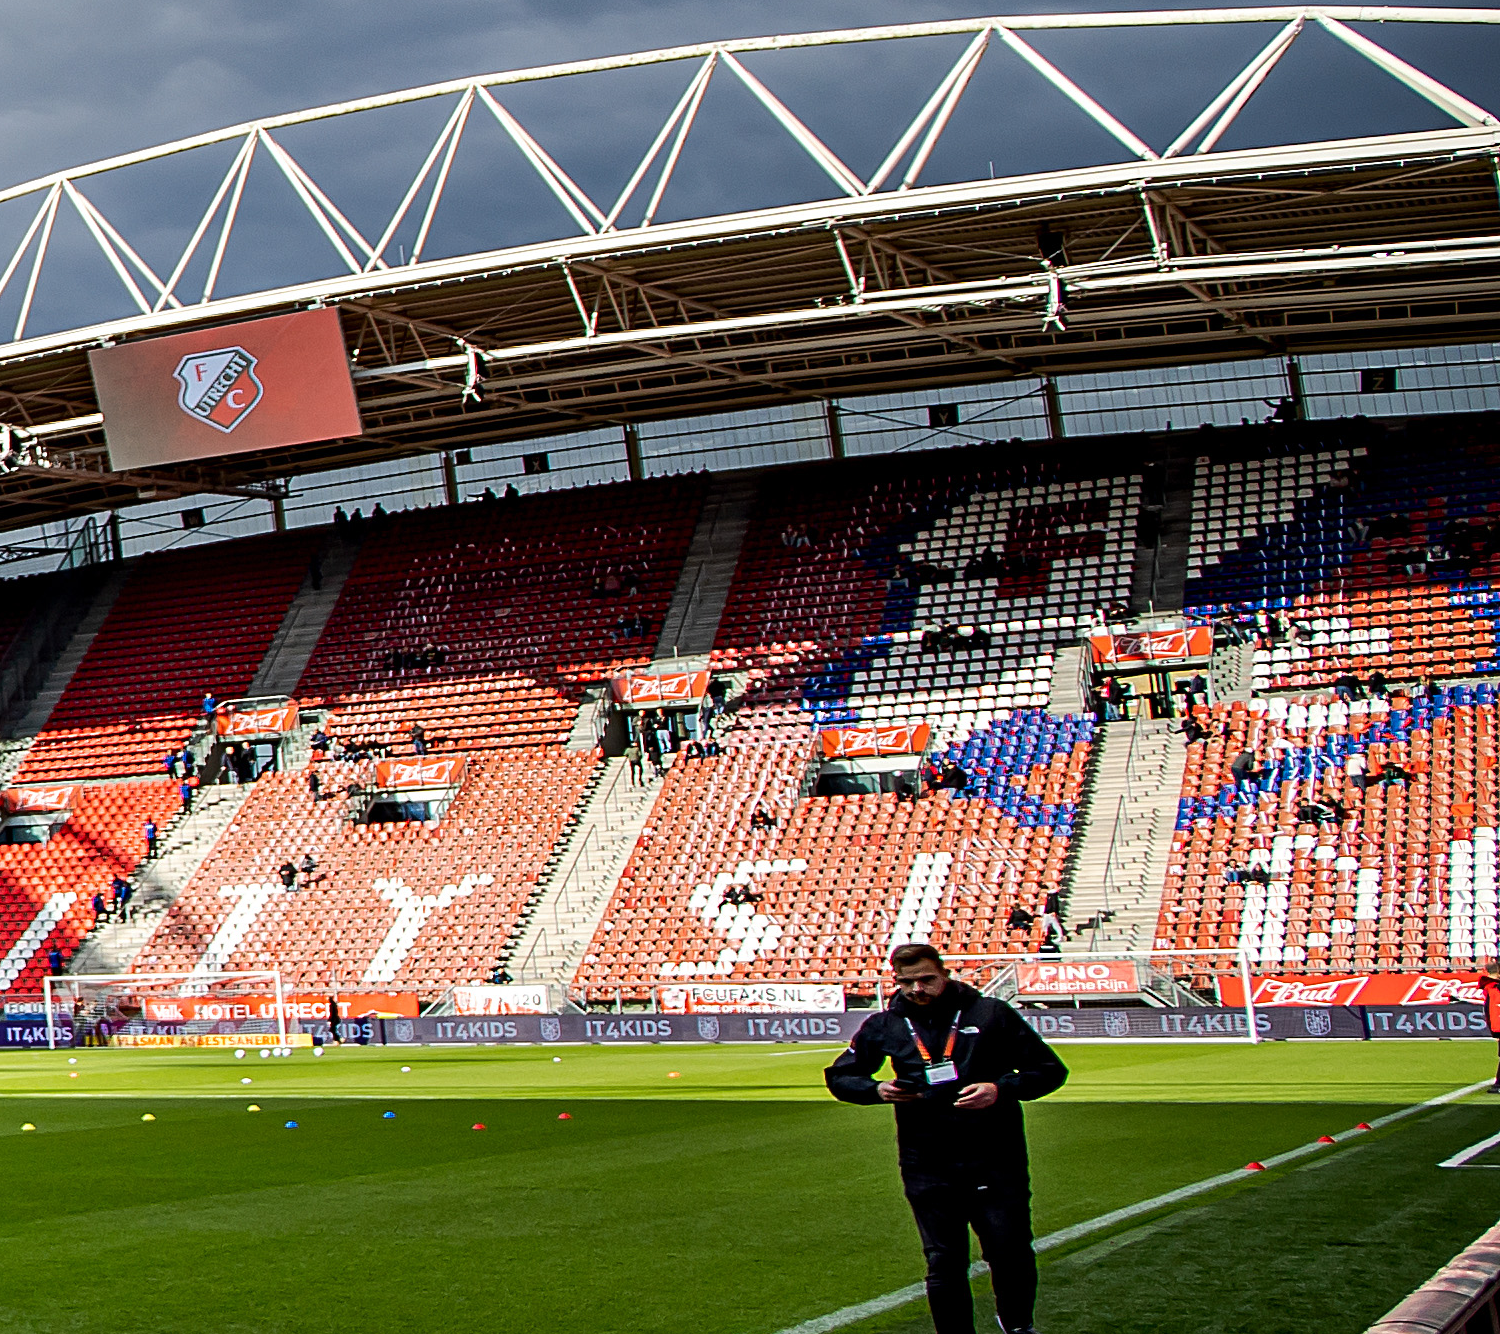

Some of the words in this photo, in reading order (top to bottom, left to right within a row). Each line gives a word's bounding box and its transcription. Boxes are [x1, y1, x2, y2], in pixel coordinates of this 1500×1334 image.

[194, 363, 207, 382] F
[195, 353, 247, 417] UTRECHT
[225, 389, 246, 409] C
[1040, 964, 1109, 980] PINO
[692, 988, 806, 1002] FCUFANS.NL
[1025, 981, 1095, 992] Leidsche
[1098, 979, 1128, 993] Rijn
[1267, 981, 1338, 1003] Bud
[194, 1003, 251, 1020] HOTEL
[436, 1021, 517, 1039] IT4KIDS
[586, 1019, 672, 1038] IT4KIDS
[748, 1018, 841, 1037] IT4KIDS
[1368, 1011, 1487, 1033] IT4KIDS
